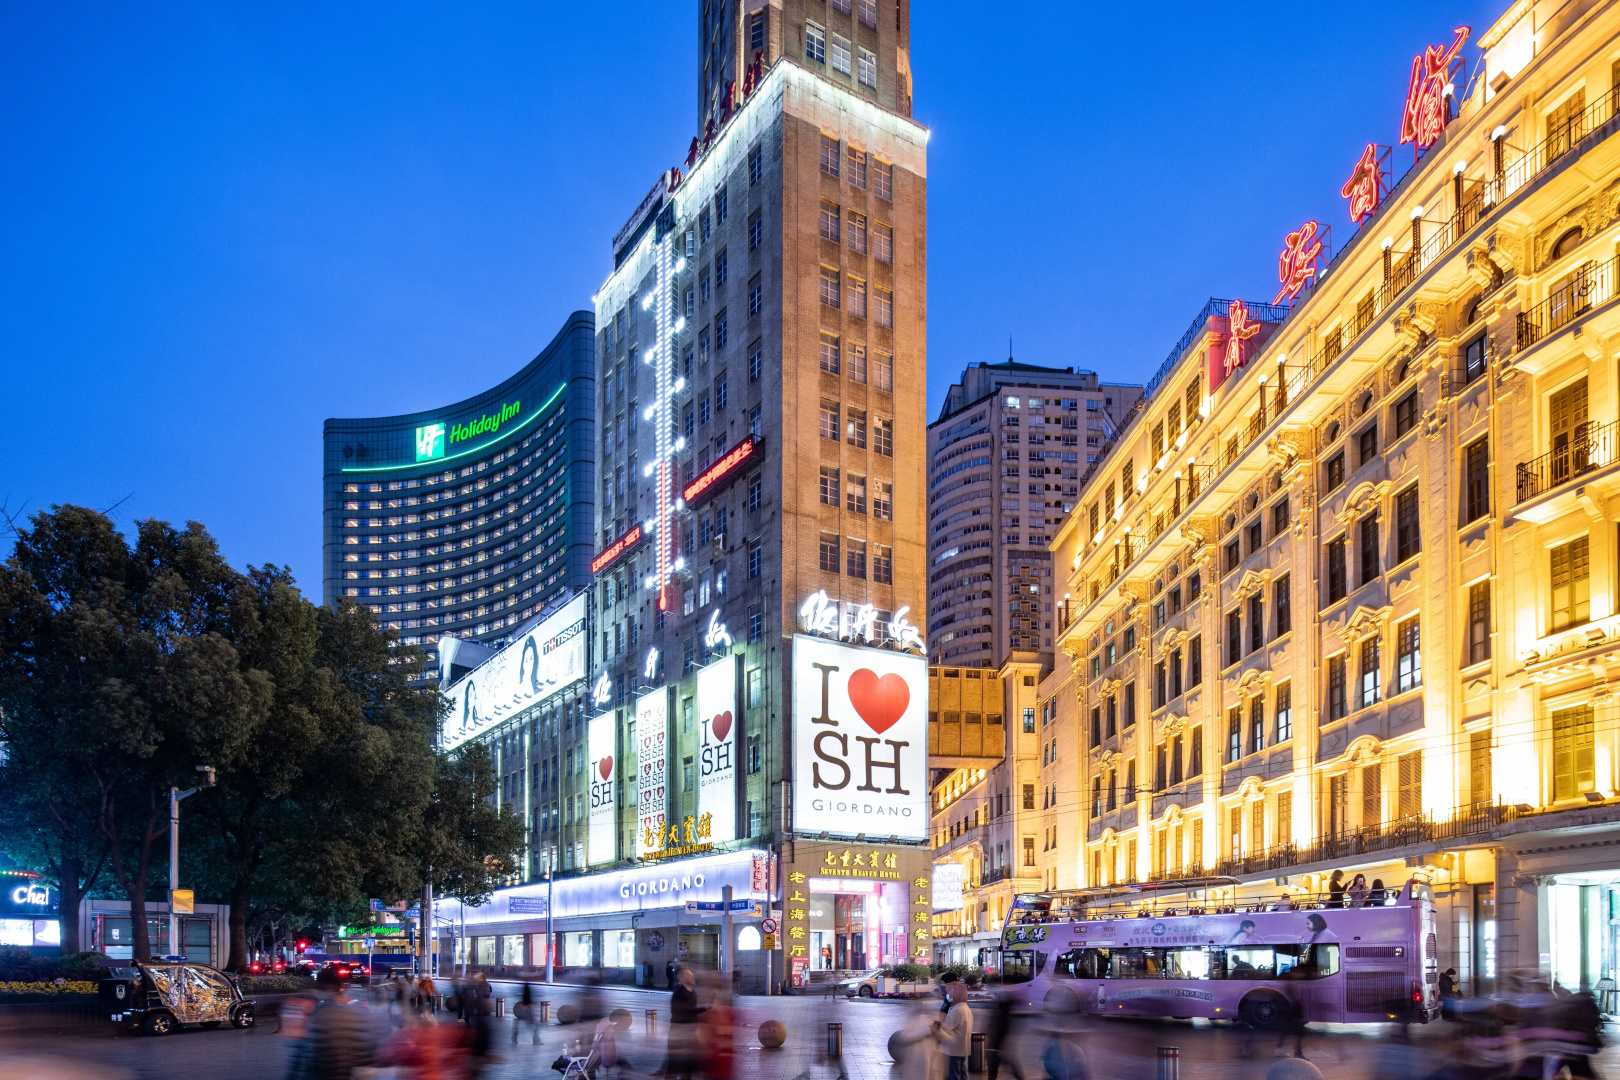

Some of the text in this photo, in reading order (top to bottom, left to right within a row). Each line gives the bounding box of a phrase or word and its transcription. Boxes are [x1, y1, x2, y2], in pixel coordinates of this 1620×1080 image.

[449, 400, 521, 444] Holiday Inn
[556, 619, 584, 647] TISSOT
[811, 662, 840, 726] I
[701, 718, 710, 748] I
[640, 743, 664, 764] SH SH
[701, 741, 732, 777] SH
[812, 730, 911, 796] SH
[591, 761, 598, 785] I
[640, 771, 664, 790] SH SH
[701, 773, 733, 787] GIORDANO
[591, 780, 614, 809] SH
[640, 798, 664, 816] SH SH
[811, 799, 912, 817] GIORDANO
[642, 841, 713, 861] SEVENTH HEAVEN HOTEL
[619, 873, 706, 899] GIORDANO
[820, 866, 901, 879] SEVENTH HEAVEN HOTEL
[789, 871, 806, 957] 老上海餐厅
[914, 877, 929, 957] 老上海餐厅
